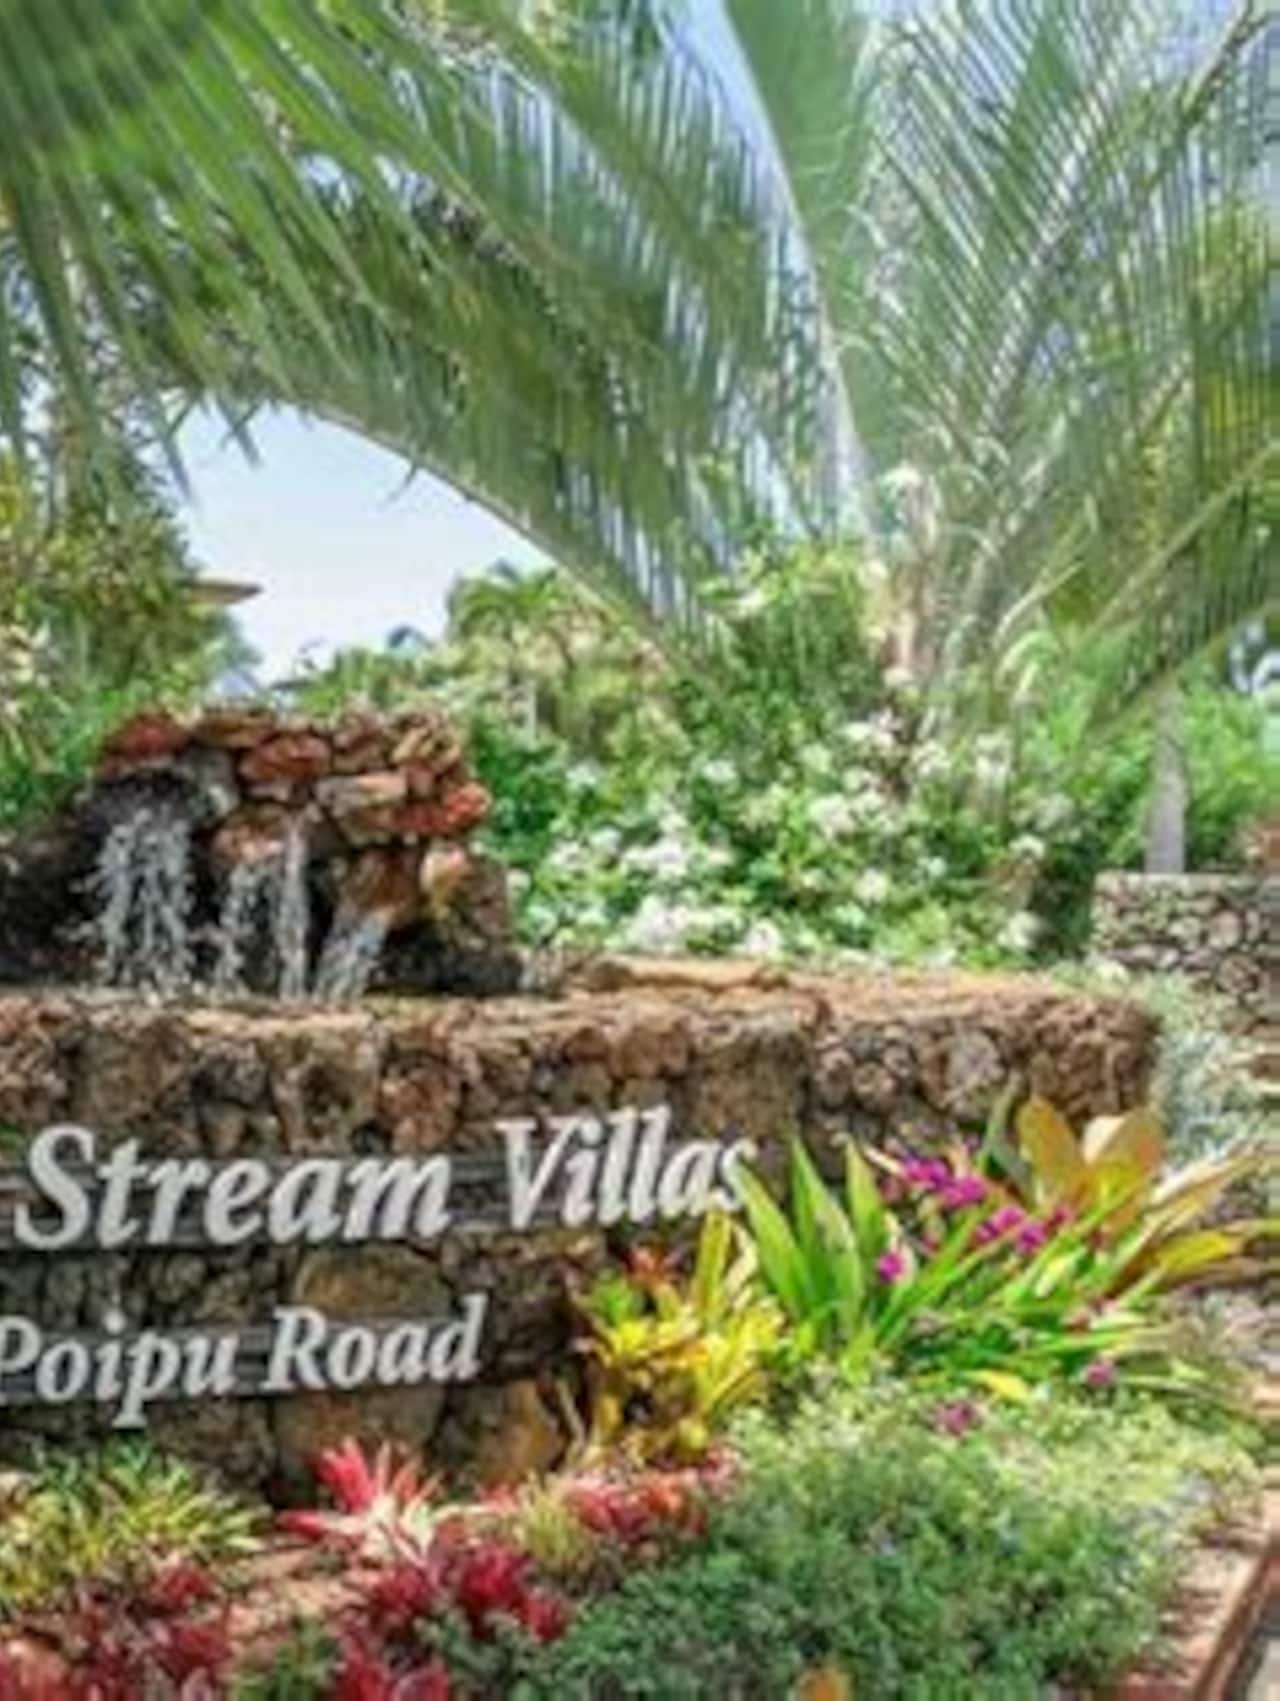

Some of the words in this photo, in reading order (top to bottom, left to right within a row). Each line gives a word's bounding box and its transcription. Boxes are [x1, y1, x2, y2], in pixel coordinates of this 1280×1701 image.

[16, 1125, 452, 1247] Stream
[497, 1105, 757, 1230] Villas
[263, 1296, 487, 1392] Road
